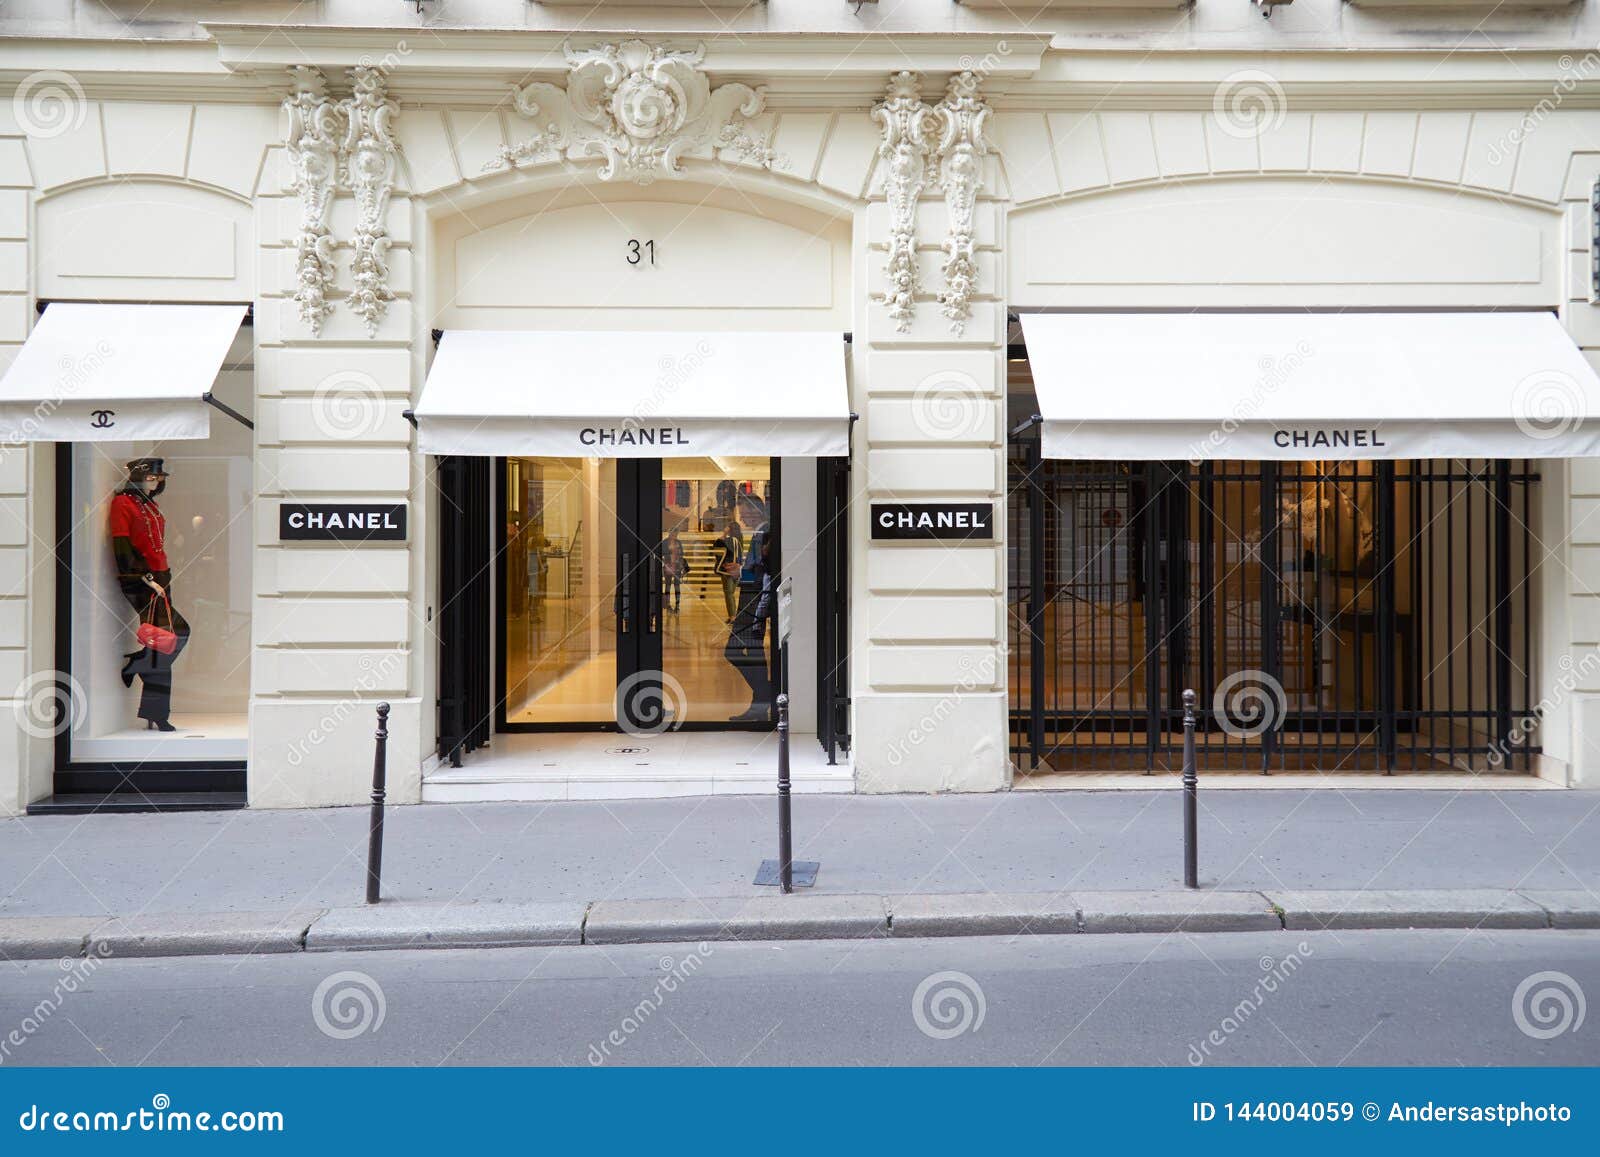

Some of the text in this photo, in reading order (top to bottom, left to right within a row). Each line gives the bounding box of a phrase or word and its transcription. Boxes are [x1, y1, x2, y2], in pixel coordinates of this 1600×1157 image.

[627, 240, 654, 265] 31
[579, 427, 690, 446] CHANEL
[1274, 429, 1385, 448] CHANEL
[288, 512, 398, 529] CHANEL
[879, 511, 986, 528] CHANEL
